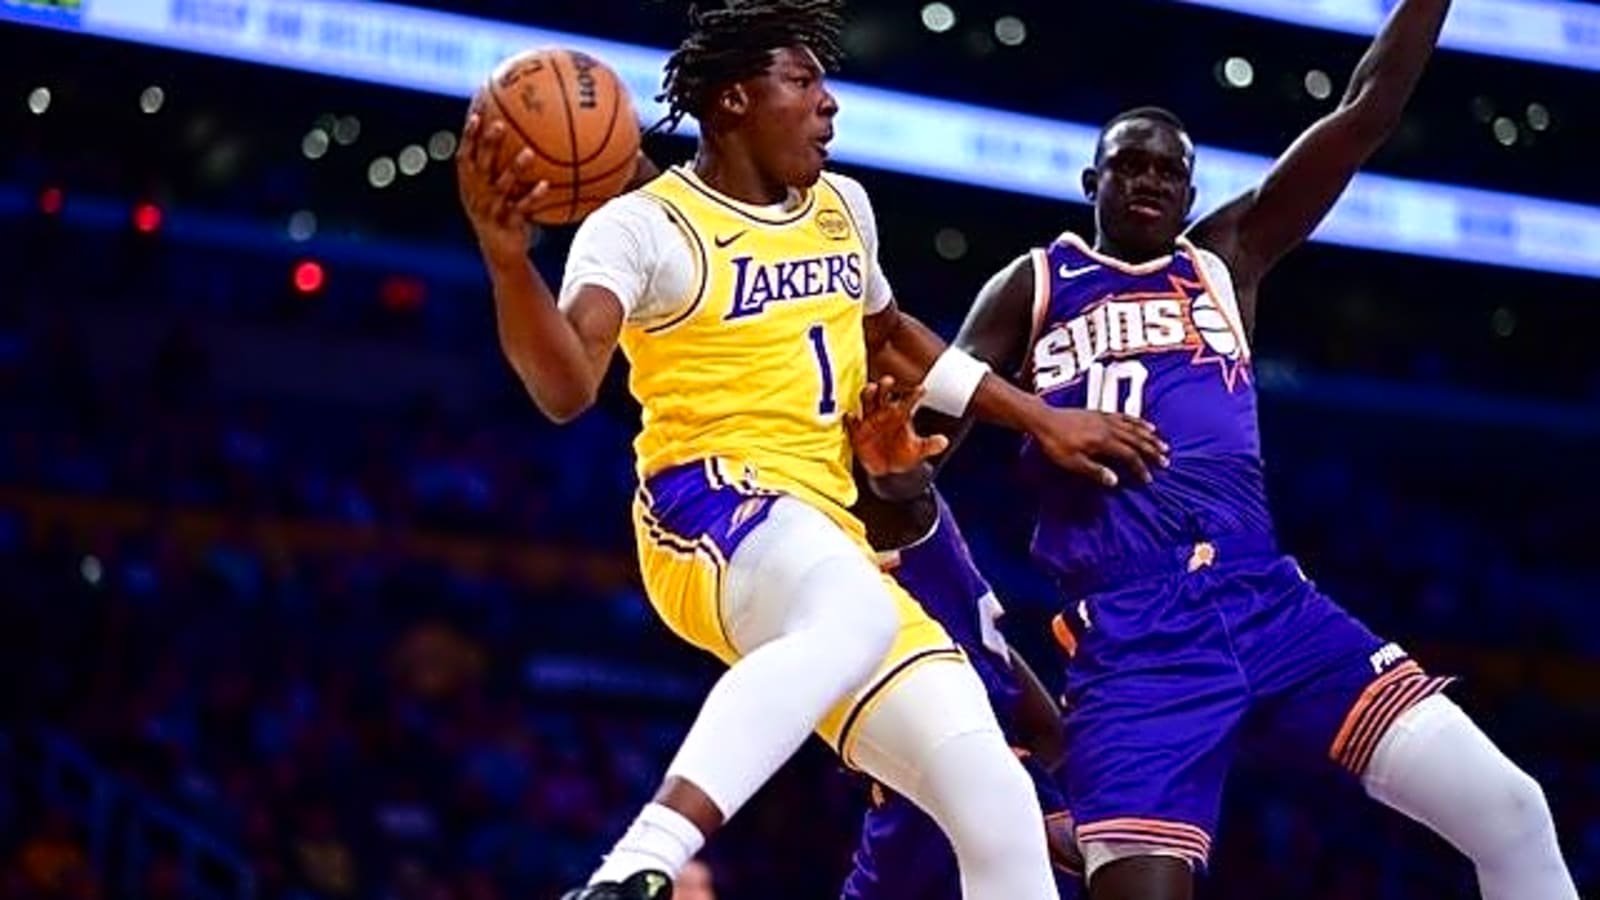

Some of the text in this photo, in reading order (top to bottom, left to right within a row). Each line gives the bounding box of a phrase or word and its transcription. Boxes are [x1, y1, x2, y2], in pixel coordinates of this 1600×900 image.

[722, 253, 863, 321] LAKERS
[808, 325, 836, 415] 1
[1033, 299, 1186, 394] SUNS
[1086, 359, 1149, 419] 10
